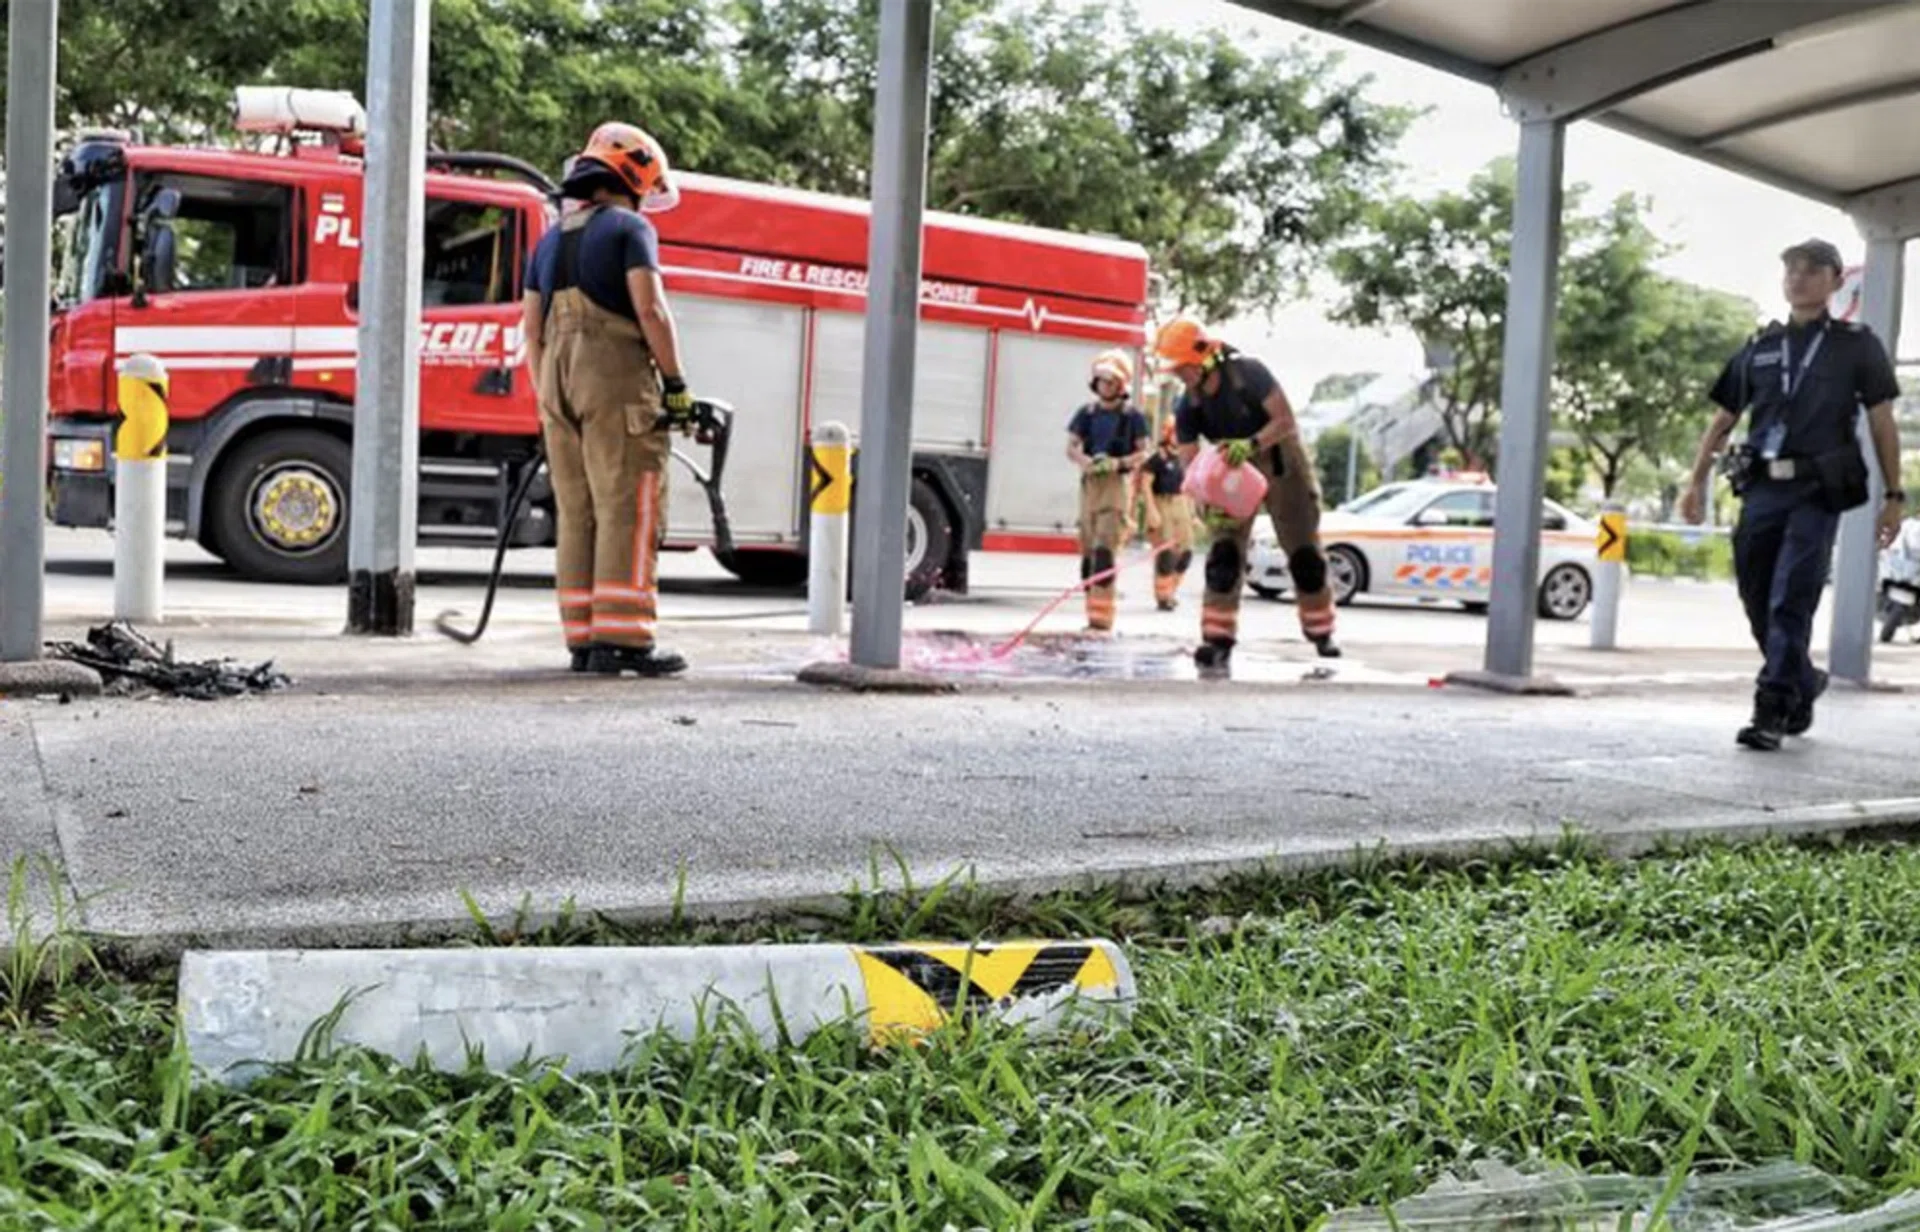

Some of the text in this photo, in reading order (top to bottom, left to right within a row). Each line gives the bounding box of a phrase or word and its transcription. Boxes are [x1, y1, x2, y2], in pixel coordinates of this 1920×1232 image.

[741, 256, 978, 305] FIRE & RESCU PONSE
[1406, 543, 1472, 564] POLICE
